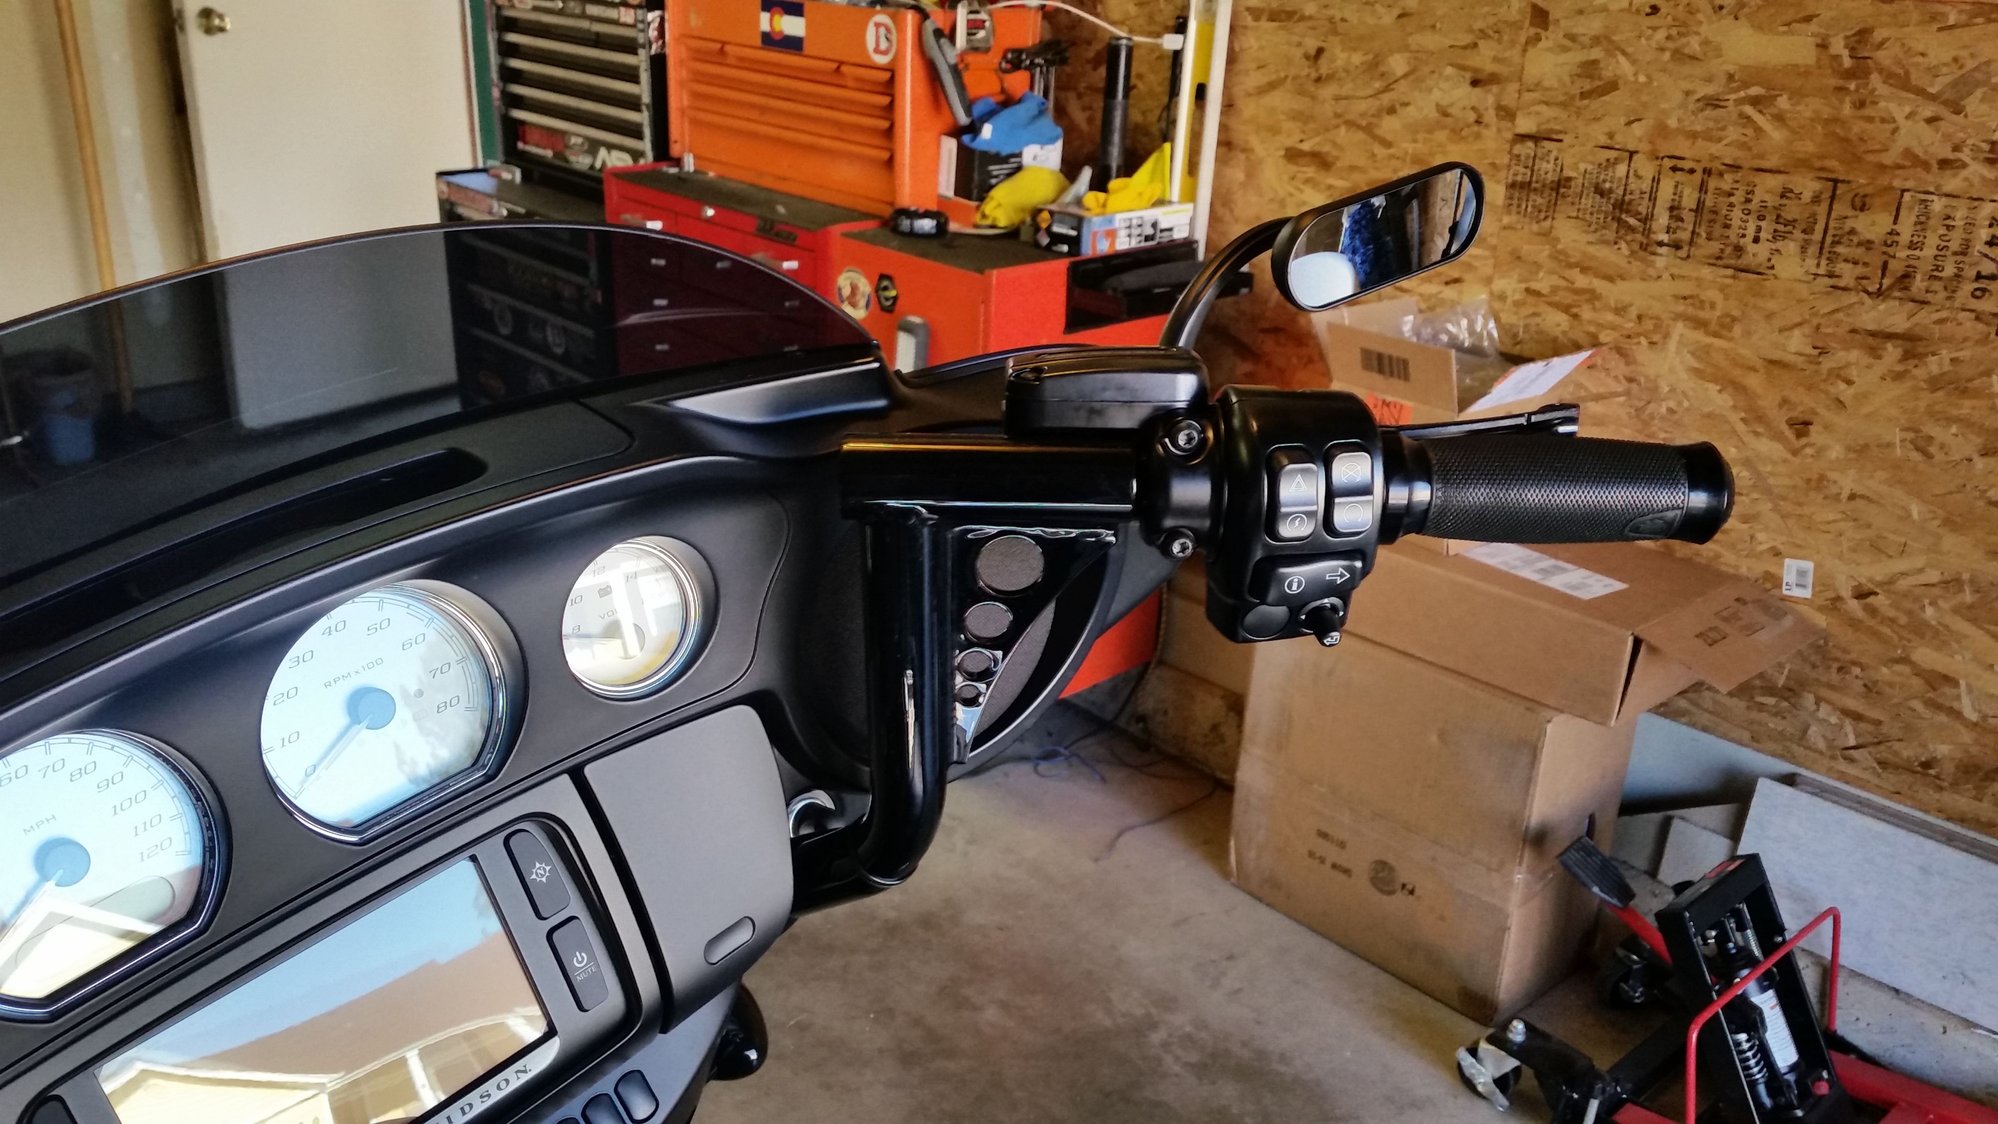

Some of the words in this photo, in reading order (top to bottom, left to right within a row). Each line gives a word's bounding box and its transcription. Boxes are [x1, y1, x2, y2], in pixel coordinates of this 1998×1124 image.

[321, 619, 347, 638] 40
[366, 617, 391, 636] 50
[401, 632, 426, 651] 60
[288, 649, 314, 669] 30
[429, 661, 451, 679] 70
[272, 686, 298, 706] 20
[436, 694, 460, 714] 80
[280, 730, 300, 749] 10
[0, 764, 28, 787] 60
[38, 758, 66, 779] 70
[69, 760, 97, 783] 80
[304, 763, 317, 777] 0
[96, 770, 124, 793] 90
[111, 789, 147, 816] 100
[23, 813, 57, 835] MPH
[133, 813, 163, 837] 110
[138, 836, 173, 863] 120
[576, 966, 598, 982] MUTE
